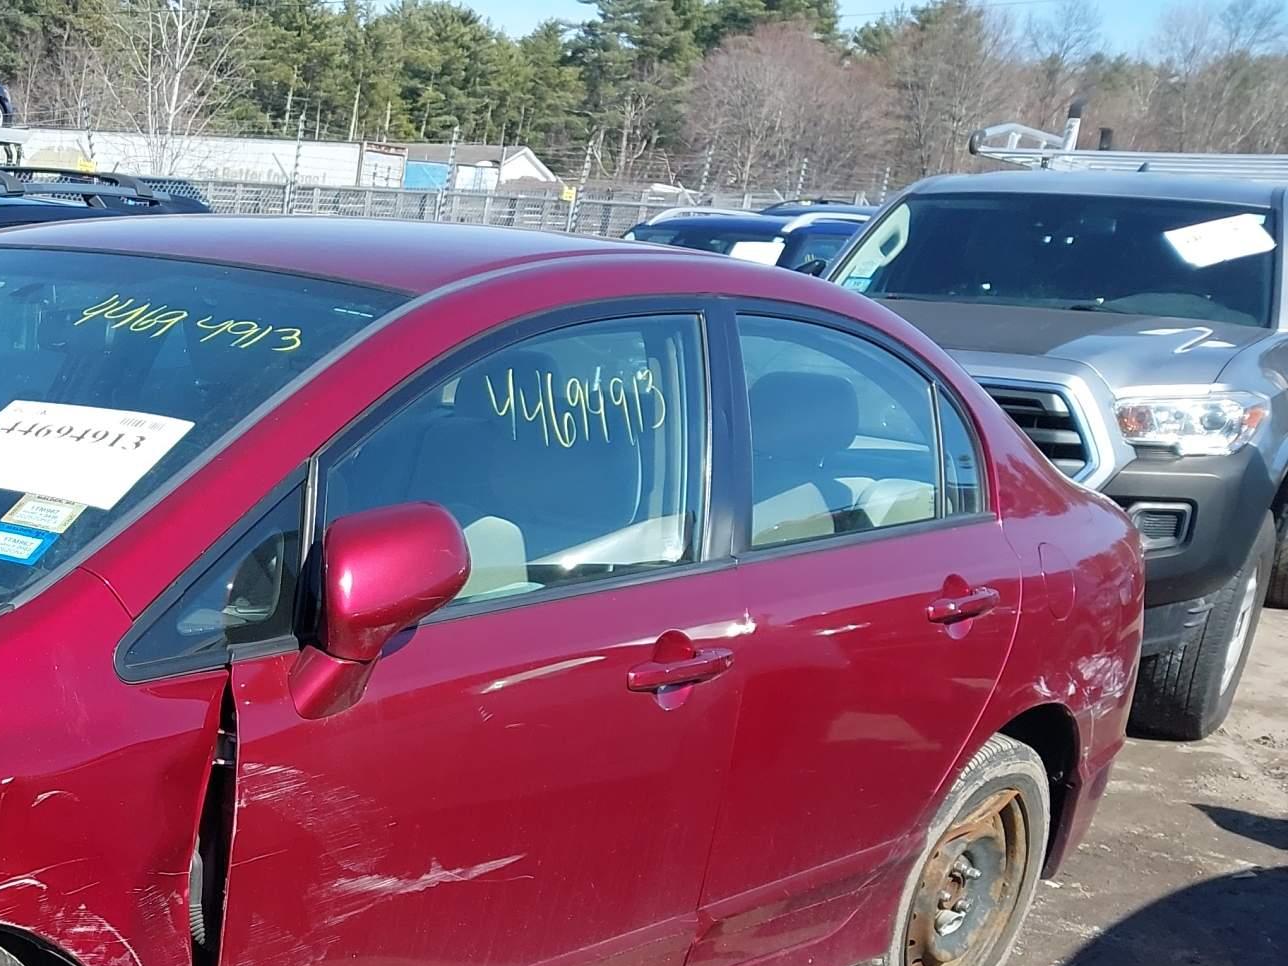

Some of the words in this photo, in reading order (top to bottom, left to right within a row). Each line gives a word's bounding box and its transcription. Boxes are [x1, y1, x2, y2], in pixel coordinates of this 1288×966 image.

[74, 294, 189, 338] 4469
[197, 315, 302, 351] 4913
[485, 366, 666, 448] 44694913
